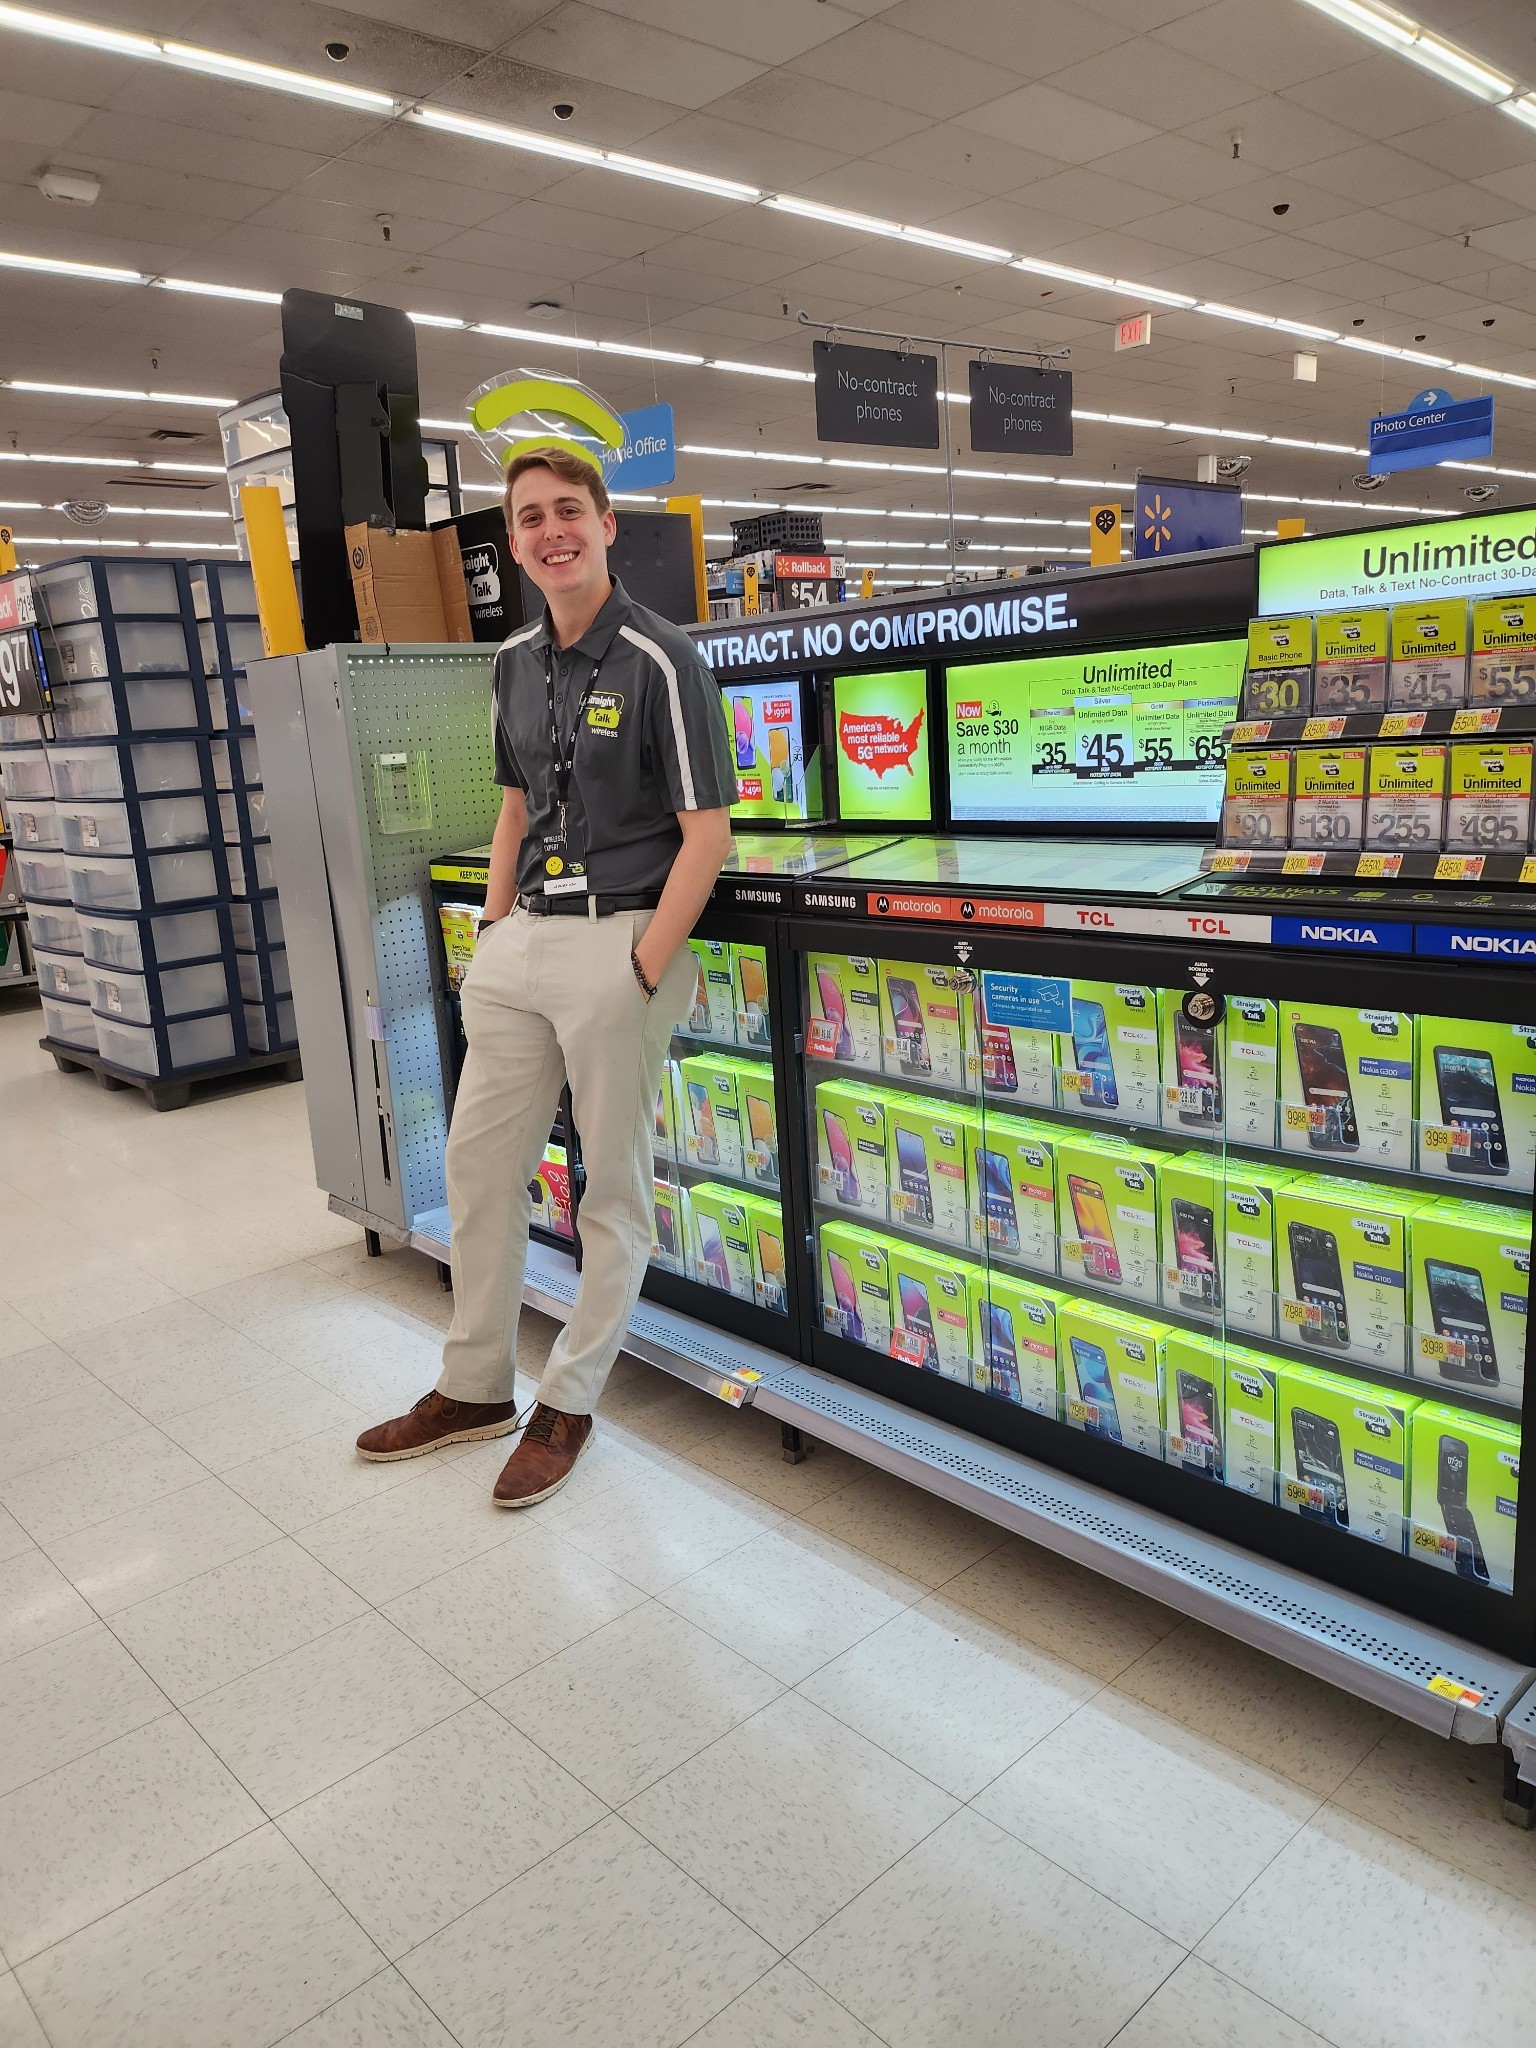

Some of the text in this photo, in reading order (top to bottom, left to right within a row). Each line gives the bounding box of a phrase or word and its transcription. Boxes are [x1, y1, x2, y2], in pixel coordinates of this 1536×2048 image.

[1120, 320, 1143, 345] EXIT
[837, 369, 918, 397] No-contract
[989, 386, 1056, 409] No-contract
[856, 401, 903, 423] phones
[1003, 414, 1043, 434] phones
[1373, 412, 1447, 434] Photo Center
[635, 436, 667, 457] Office
[462, 552, 490, 572] raight
[791, 561, 826, 574] Rollback
[1320, 566, 1536, 600] Data, Talk & Text No-Contract 30-Da
[473, 581, 492, 598] Talk
[748, 595, 754, 604] F
[474, 605, 504, 620] wireless
[746, 608, 758, 616] 30
[698, 593, 1078, 668] NTRACT. NO COMPROMISE.
[1325, 643, 1376, 656] Unlimited
[1401, 641, 1456, 655] Unlimited
[1258, 652, 1303, 662] Basic Phone
[1083, 659, 1172, 684] Unlimited
[1111, 683, 1151, 692] No-Contract
[1152, 681, 1175, 689] 30-Day
[1177, 679, 1197, 687] Plans
[1403, 673, 1452, 702] $45
[1479, 664, 1535, 699] $55
[1251, 679, 1300, 711] $30
[1320, 675, 1370, 705] $35
[956, 704, 981, 718] Now
[1078, 710, 1110, 719] Unlimited
[1187, 711, 1216, 719] Unlimited
[595, 713, 611, 723] Talk
[1136, 714, 1164, 722] Unlimited
[591, 727, 618, 738] wireless
[842, 722, 882, 733] America's
[956, 719, 1019, 737] Save $30
[847, 731, 900, 744] most reliable
[857, 743, 908, 760] 5G network
[957, 738, 1011, 754] a month
[1081, 734, 1124, 766] $45
[1139, 738, 1173, 761] $55
[1189, 736, 1226, 760] $65
[1036, 742, 1067, 765] $35
[1234, 780, 1281, 791] Unlimited
[1304, 781, 1355, 791] Unlimited
[1379, 778, 1433, 789] Unlimited
[1463, 778, 1522, 789] Unlimited
[1235, 814, 1272, 840] $90
[1299, 815, 1351, 840] $130
[1372, 814, 1431, 843] $255
[1460, 816, 1518, 844] $495
[460, 870, 488, 880] KEEP YOUR
[1437, 862, 1461, 876] 49500
[735, 889, 781, 904] SAMSUNG
[1284, 887, 1341, 895] WAYS
[804, 893, 857, 909] SAMSUNG
[892, 900, 942, 914] motorola
[978, 905, 1034, 921] motorola
[1076, 910, 1115, 927] TCL
[1187, 918, 1231, 935] TCL
[1301, 925, 1379, 944] NOKIA
[1451, 935, 1536, 954] NOKIA
[991, 983, 1018, 994] Security
[1119, 988, 1141, 996] Straight
[992, 994, 1018, 1002] cameras
[1236, 1000, 1261, 1009] Straight
[1247, 1012, 1260, 1020] Talk
[1363, 1013, 1393, 1023] Straight
[1377, 1026, 1393, 1034] Talk
[1376, 1035, 1399, 1043] wireless
[814, 1043, 834, 1054] Rollback
[1241, 1047, 1254, 1055] TCL
[1361, 1065, 1398, 1076] Nokia G300
[1515, 1083, 1535, 1092] Nokia
[1020, 1147, 1039, 1156] Straight
[1030, 1158, 1040, 1166] Talk
[1119, 1169, 1140, 1178] Straight
[1129, 1181, 1140, 1189] Talk
[1231, 1193, 1256, 1204] Straight
[1122, 1210, 1135, 1218] TCL
[1242, 1205, 1256, 1214] Talk
[1357, 1220, 1385, 1232] Straight
[1236, 1238, 1252, 1247] TCL
[1369, 1233, 1385, 1243] Talk
[1356, 1264, 1373, 1272] NOKIA
[1356, 1270, 1392, 1284] Nokia G100
[945, 1287, 956, 1295] Talk
[1503, 1295, 1523, 1303] NOKIA
[1023, 1304, 1042, 1314] Straight
[1503, 1302, 1524, 1313] Nokia
[1032, 1315, 1043, 1323] Talk
[1119, 1338, 1141, 1349] Straight
[1129, 1350, 1141, 1360] Talk
[1234, 1372, 1258, 1386] Straight
[1246, 1386, 1259, 1396] Talk
[1240, 1416, 1255, 1427] TCL
[1358, 1411, 1386, 1424] Straight
[1370, 1424, 1386, 1435] Talk
[1356, 1452, 1373, 1461] NOKIA
[1356, 1458, 1391, 1475] Nokia C200
[1414, 1530, 1436, 1547] 2988
